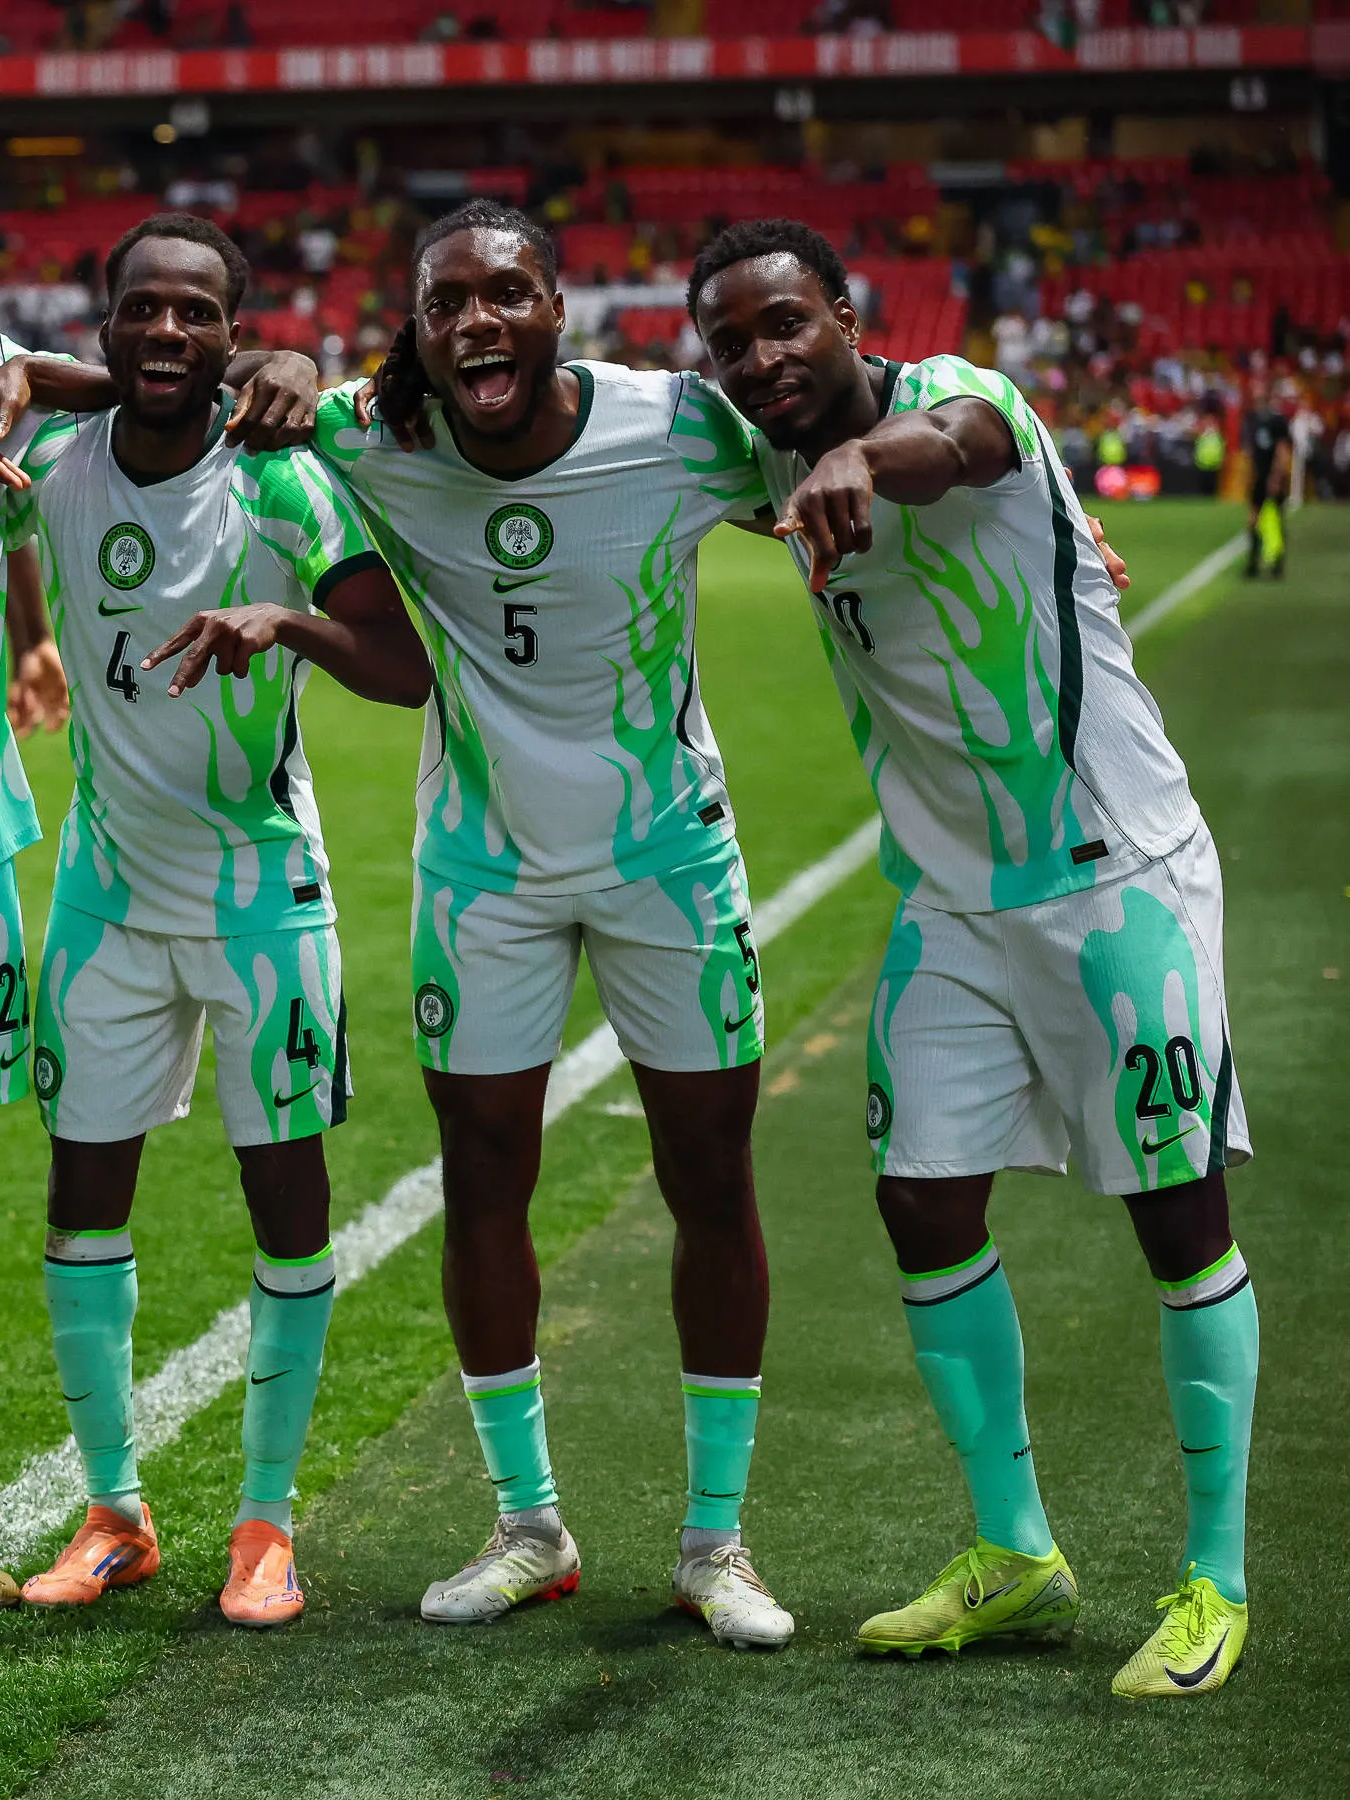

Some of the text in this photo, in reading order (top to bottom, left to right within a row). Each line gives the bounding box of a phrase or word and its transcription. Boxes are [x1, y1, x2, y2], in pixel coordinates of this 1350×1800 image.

[106, 630, 141, 703] 4
[503, 603, 539, 668] 5
[733, 921, 760, 995] 5
[286, 996, 322, 1070] 4
[1124, 1035, 1204, 1121] 20
